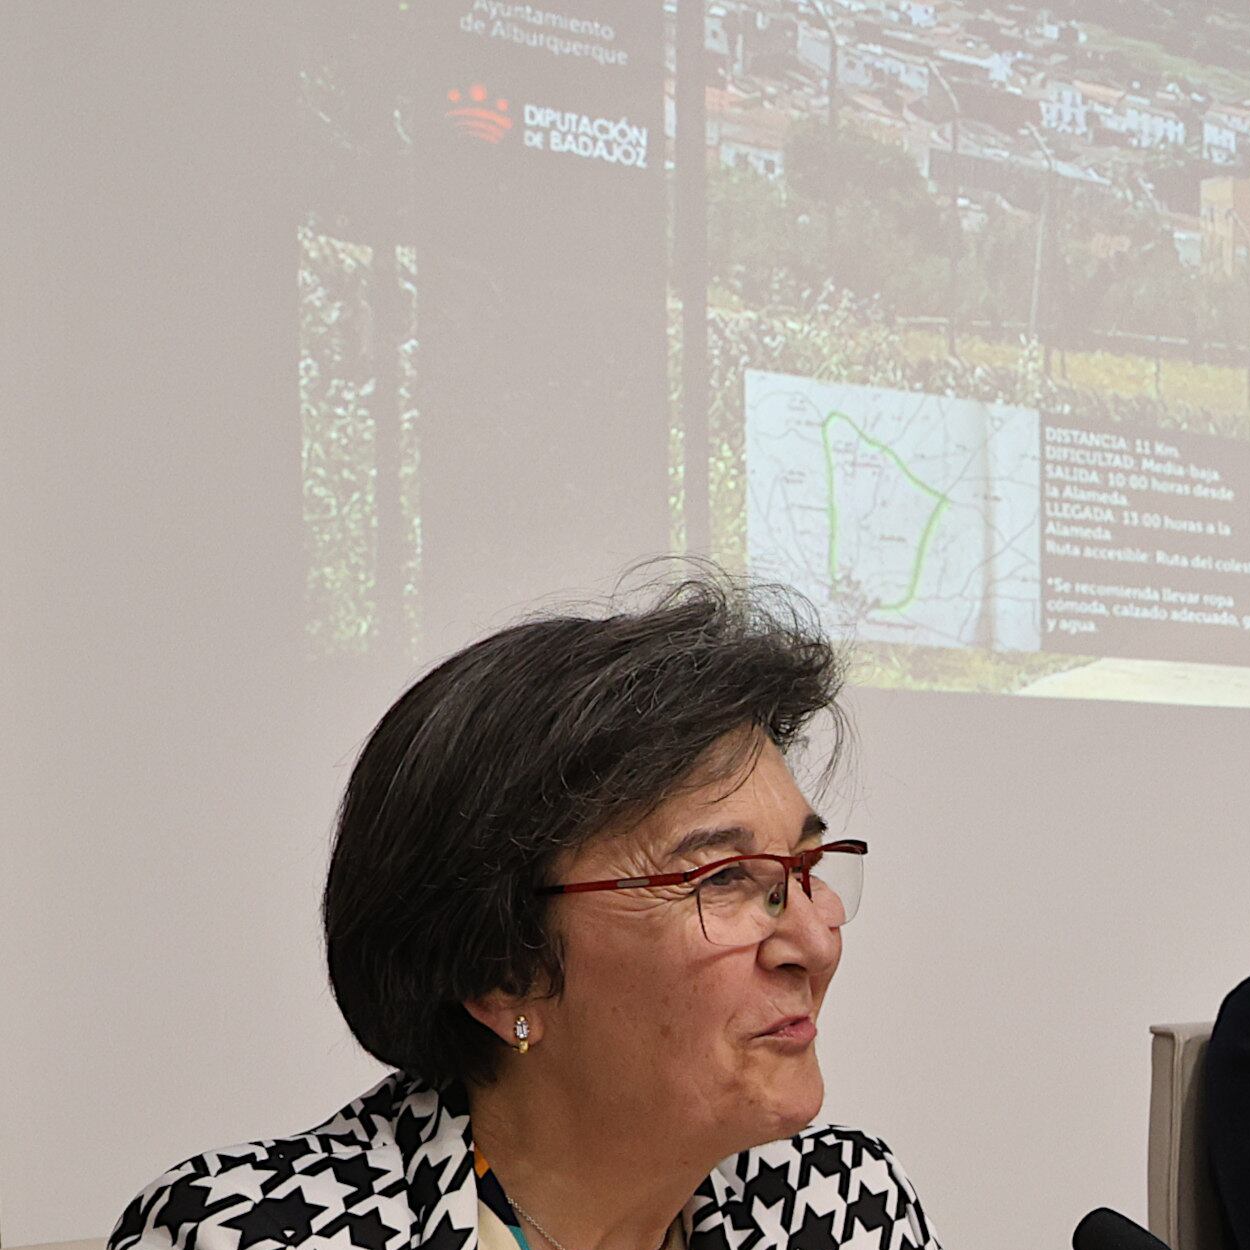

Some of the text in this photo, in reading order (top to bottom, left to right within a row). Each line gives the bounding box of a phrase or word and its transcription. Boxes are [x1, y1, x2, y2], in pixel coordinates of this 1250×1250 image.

[473, 0, 615, 41] Ayuntamiento
[460, 12, 628, 66] de Alburquerque
[524, 104, 648, 147] DIPUTACIÓN
[550, 129, 648, 170] BADAJOZ
[1135, 438, 1151, 455] 11
[1046, 484, 1059, 498] la
[1152, 477, 1191, 497] horas
[1194, 484, 1235, 502] desde
[1164, 514, 1203, 534] horas
[1205, 522, 1215, 534] a
[1218, 520, 1231, 536] la
[1046, 541, 1080, 558] Ruta
[1156, 547, 1190, 569] Ruta
[1192, 554, 1214, 570] del
[1075, 580, 1159, 603] recomienda
[1162, 587, 1201, 605] llevar
[1203, 594, 1234, 610] ropa
[1113, 601, 1167, 620] calzado
[1047, 618, 1056, 632] y
